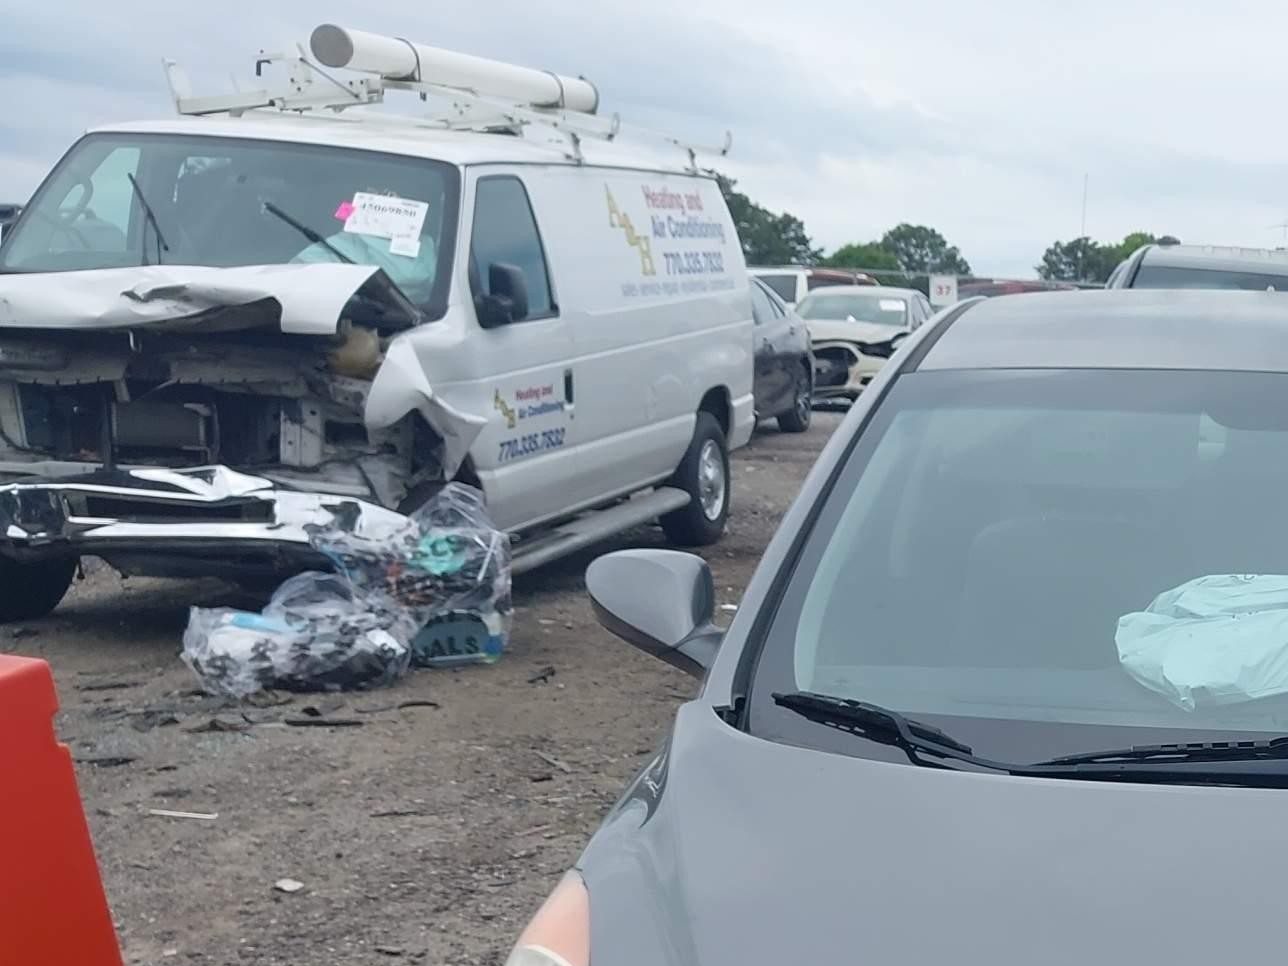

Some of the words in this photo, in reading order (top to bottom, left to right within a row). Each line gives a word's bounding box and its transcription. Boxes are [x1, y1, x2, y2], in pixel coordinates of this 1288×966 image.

[641, 184, 686, 215] Heating
[685, 189, 703, 211] and
[651, 215, 667, 238] Air
[667, 215, 727, 245] Conditioning
[516, 387, 540, 400] Heating
[541, 385, 554, 396] and
